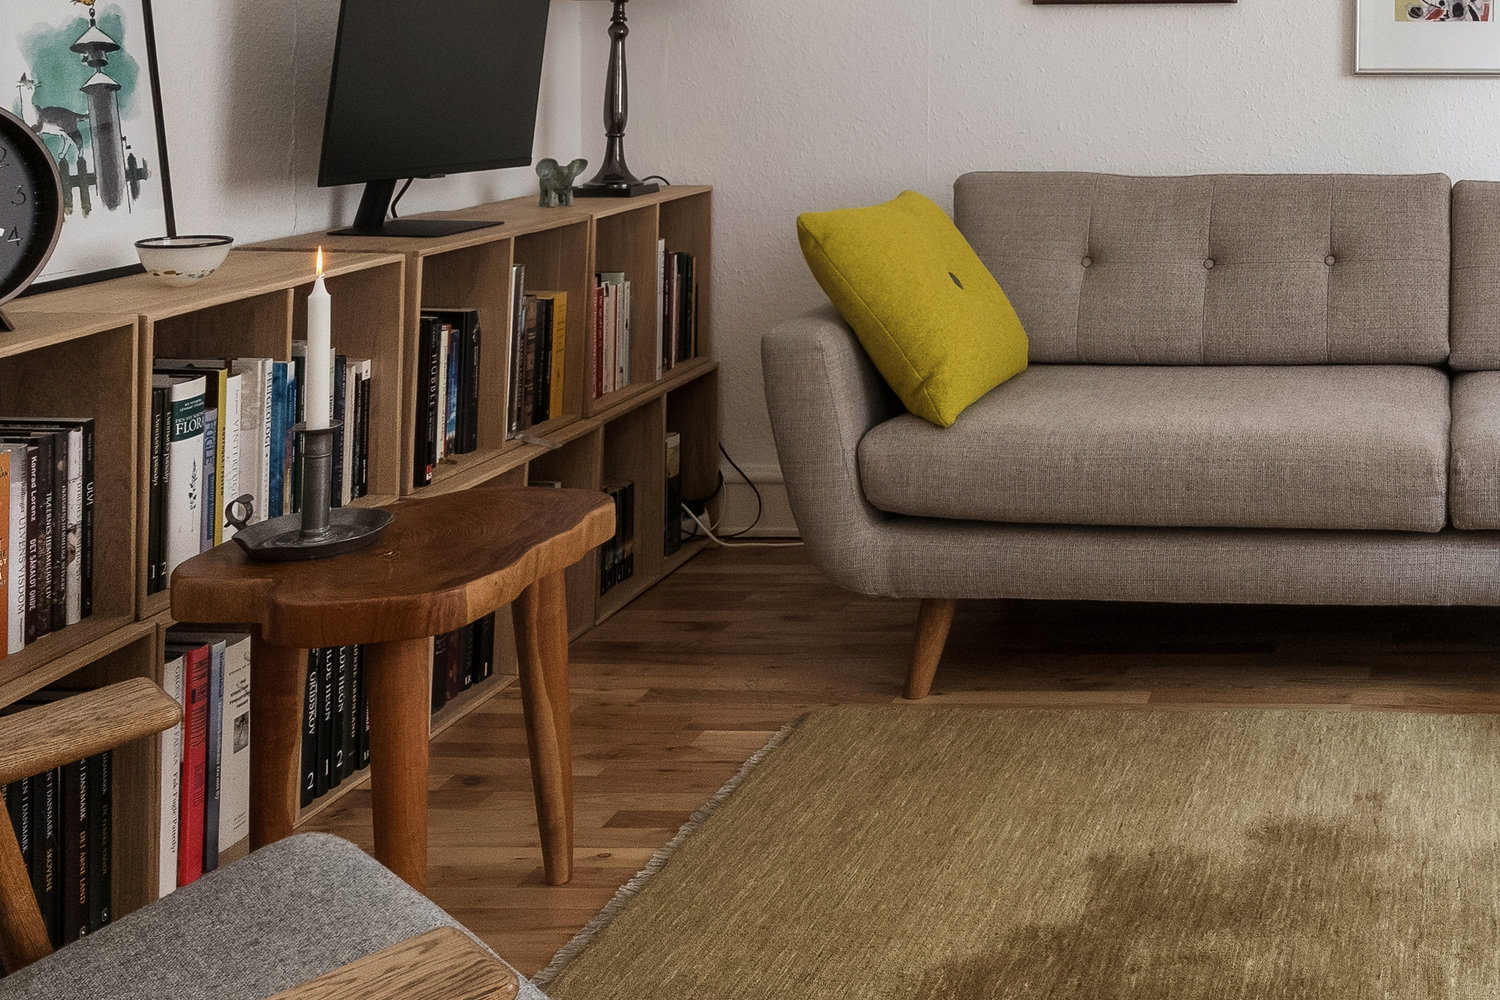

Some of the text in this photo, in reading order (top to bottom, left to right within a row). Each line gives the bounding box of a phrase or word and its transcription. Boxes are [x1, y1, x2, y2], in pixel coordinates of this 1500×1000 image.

[10, 184, 27, 206] 3
[7, 225, 24, 247] 4
[203, 418, 217, 466] FUGLE
[29, 455, 38, 522] Konrad Lorenz
[18, 515, 27, 564] ULVENS
[29, 538, 37, 553] DET
[150, 564, 156, 579] 1
[160, 561, 167, 576] 2
[16, 567, 26, 615] VISDOM
[28, 590, 36, 612] ONDE
[324, 758, 329, 776] 1
[336, 749, 343, 768] 2
[306, 771, 314, 791] 2
